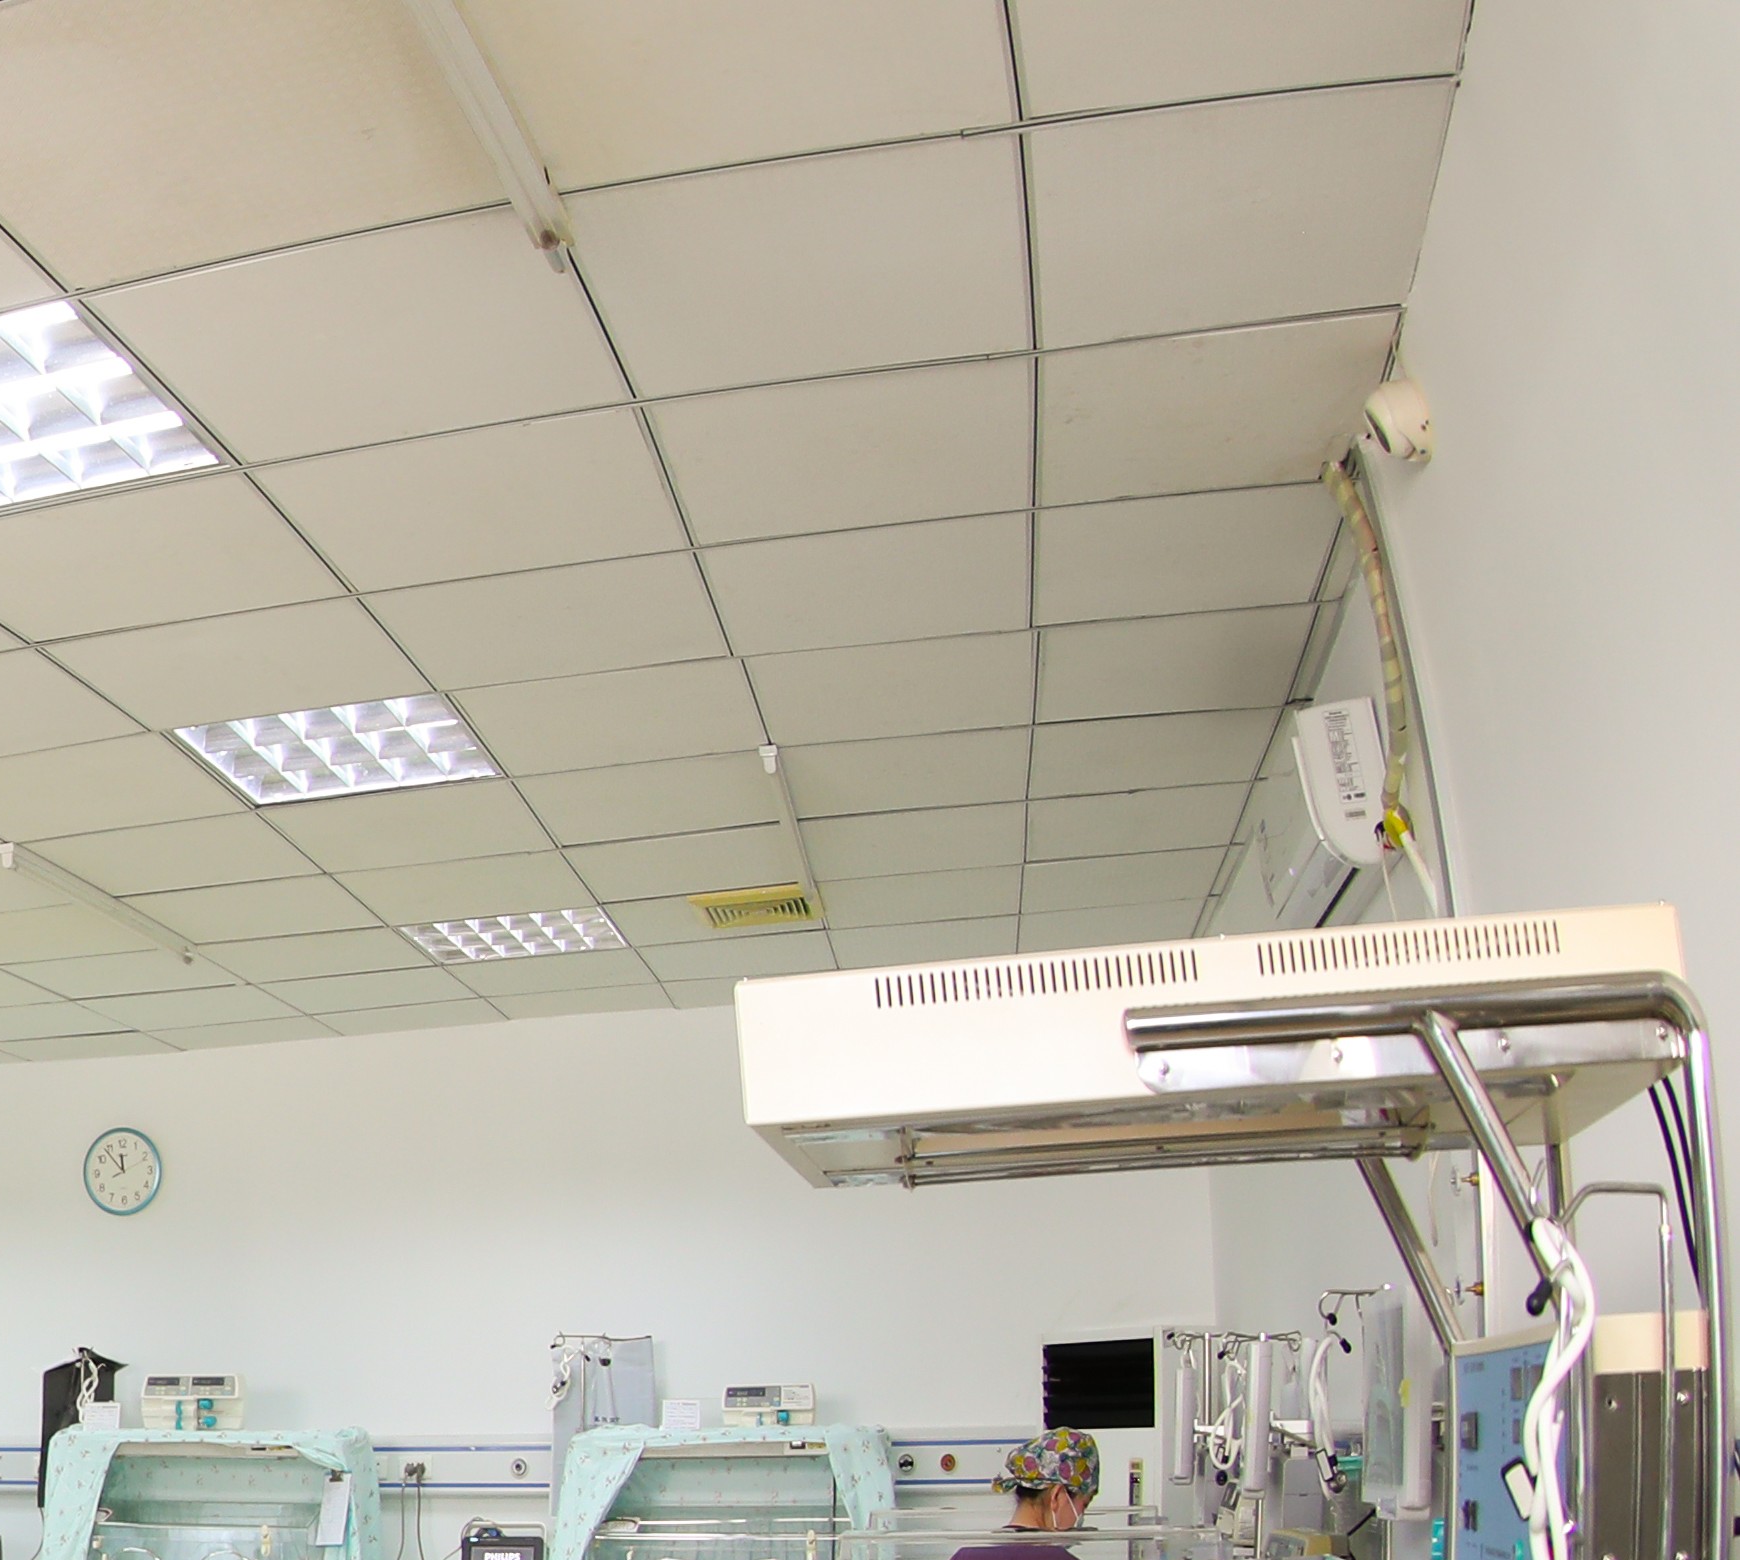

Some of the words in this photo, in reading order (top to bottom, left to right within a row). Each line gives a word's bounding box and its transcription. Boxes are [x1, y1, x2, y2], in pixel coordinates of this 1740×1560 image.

[118, 1138, 127, 1149] 12
[98, 1154, 107, 1164] 10
[142, 1152, 149, 1161] 2
[94, 1169, 101, 1178] 9
[147, 1165, 153, 1175] 3
[99, 1183, 106, 1193] 8
[143, 1181, 149, 1189] 4
[109, 1192, 115, 1202] 7
[121, 1195, 128, 1205] 6
[134, 1191, 141, 1201] 5
